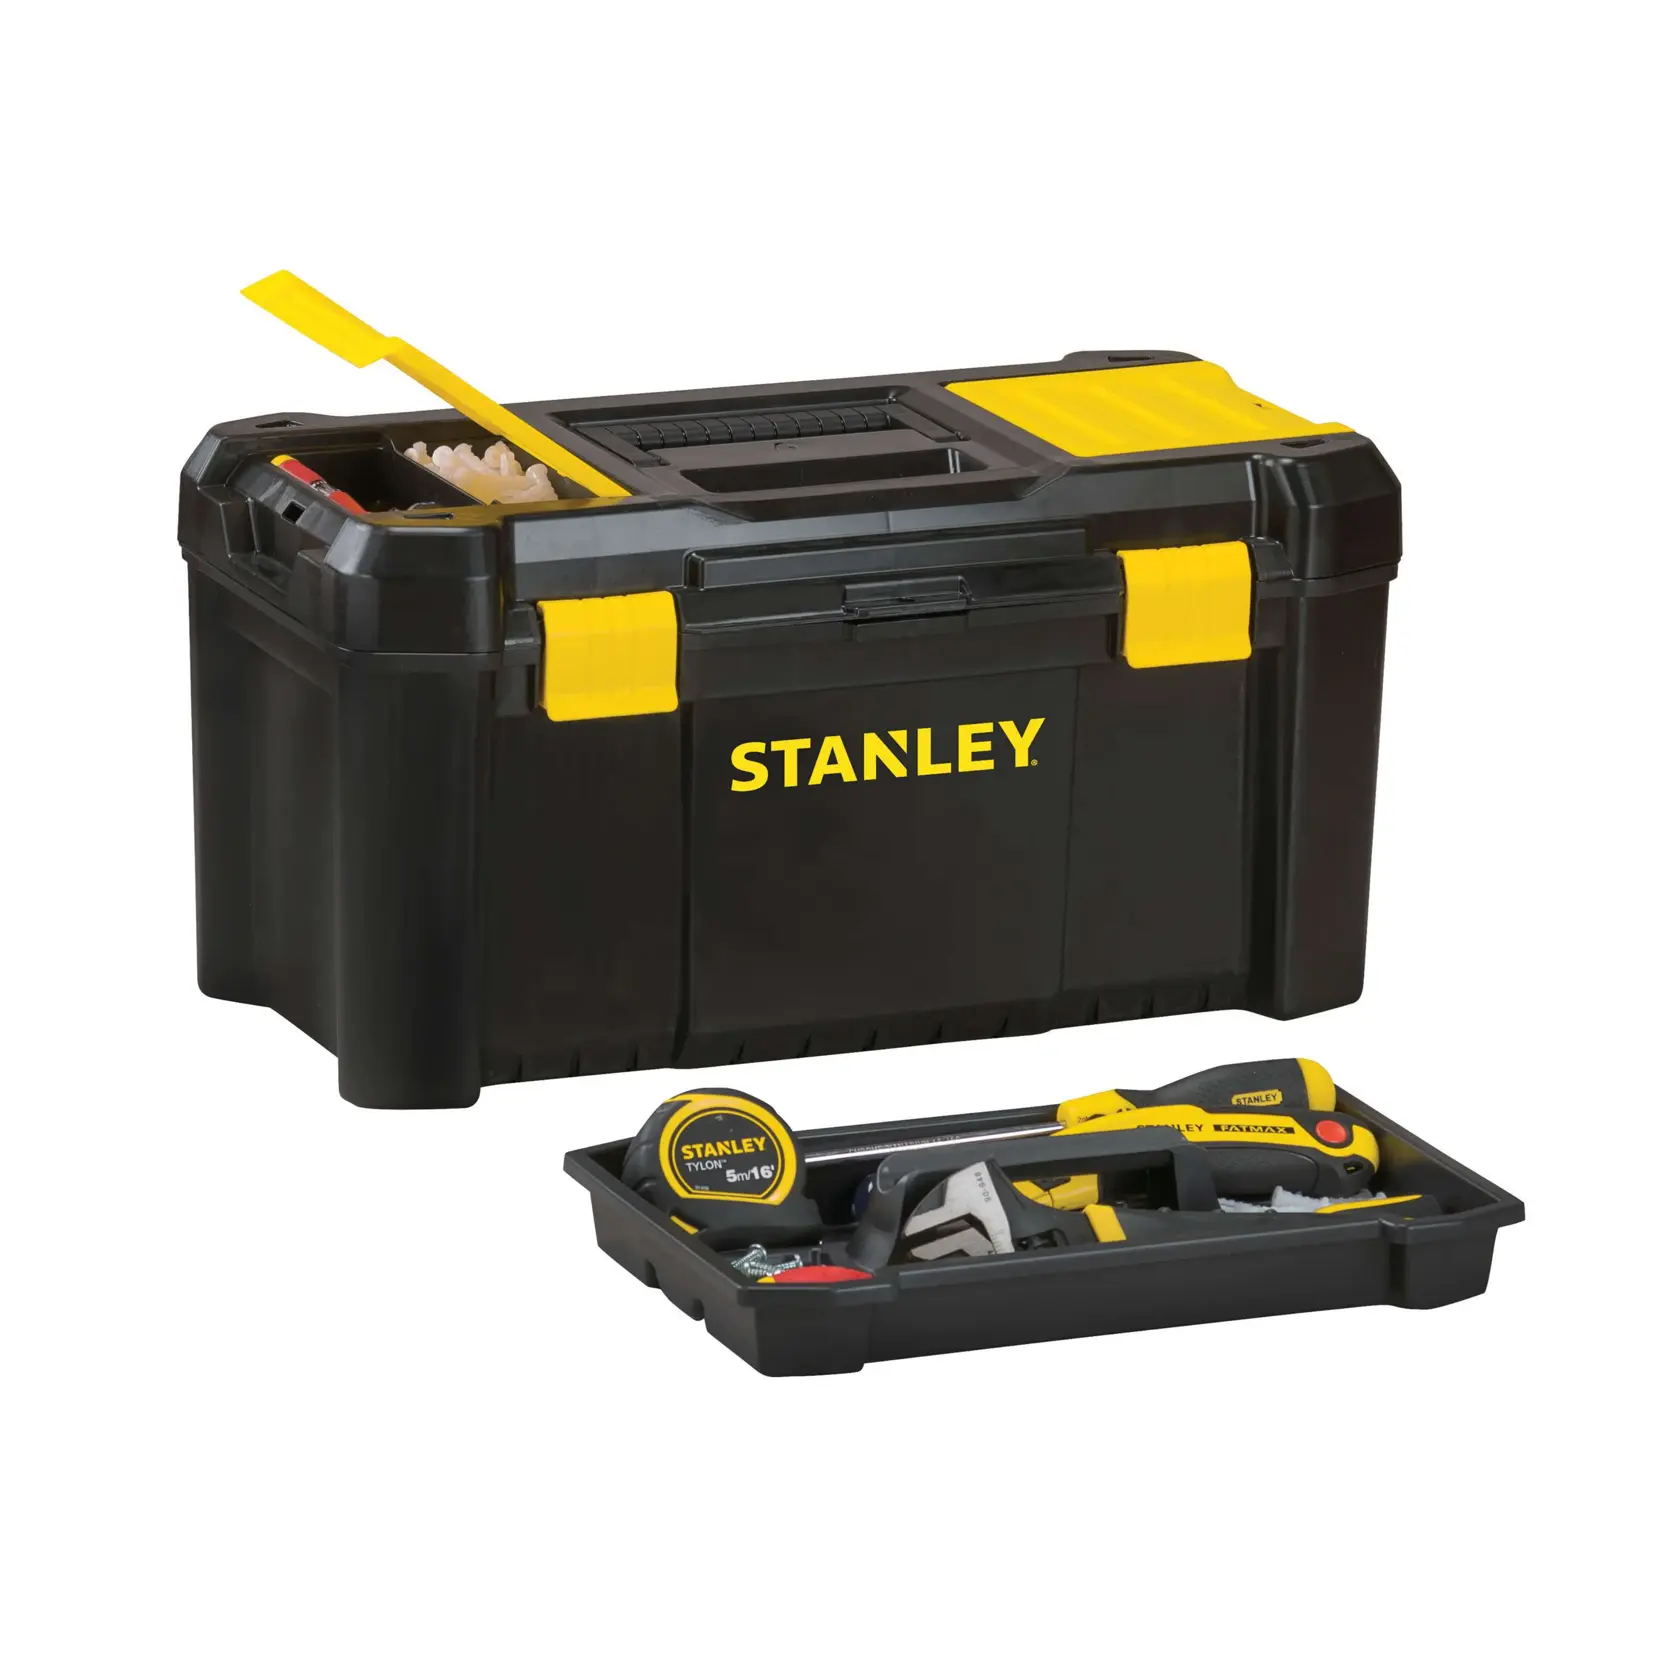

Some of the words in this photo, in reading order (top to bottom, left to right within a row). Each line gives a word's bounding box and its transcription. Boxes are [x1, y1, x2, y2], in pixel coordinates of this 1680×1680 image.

[731, 717, 1046, 792] STANLEY
[1236, 1093, 1277, 1106] STANLEY
[1220, 1125, 1287, 1134] FATMAX
[681, 1136, 766, 1160] STANLEY
